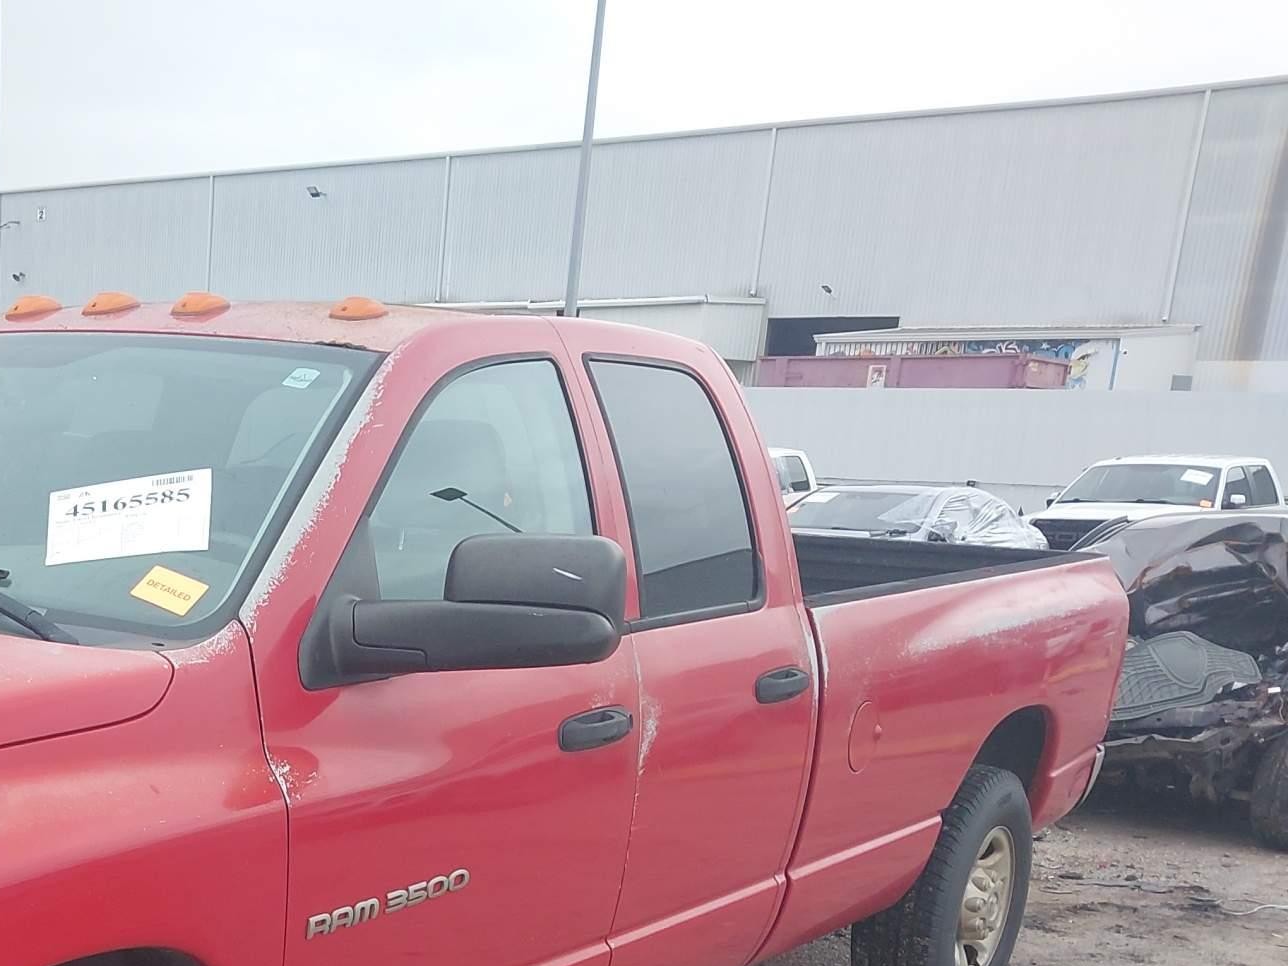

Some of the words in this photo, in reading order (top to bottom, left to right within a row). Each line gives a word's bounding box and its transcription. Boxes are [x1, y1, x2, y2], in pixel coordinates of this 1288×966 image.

[65, 487, 190, 517] 45165585
[146, 578, 191, 602] DETAILED
[306, 897, 380, 940] RAM
[385, 868, 471, 914] 3500
